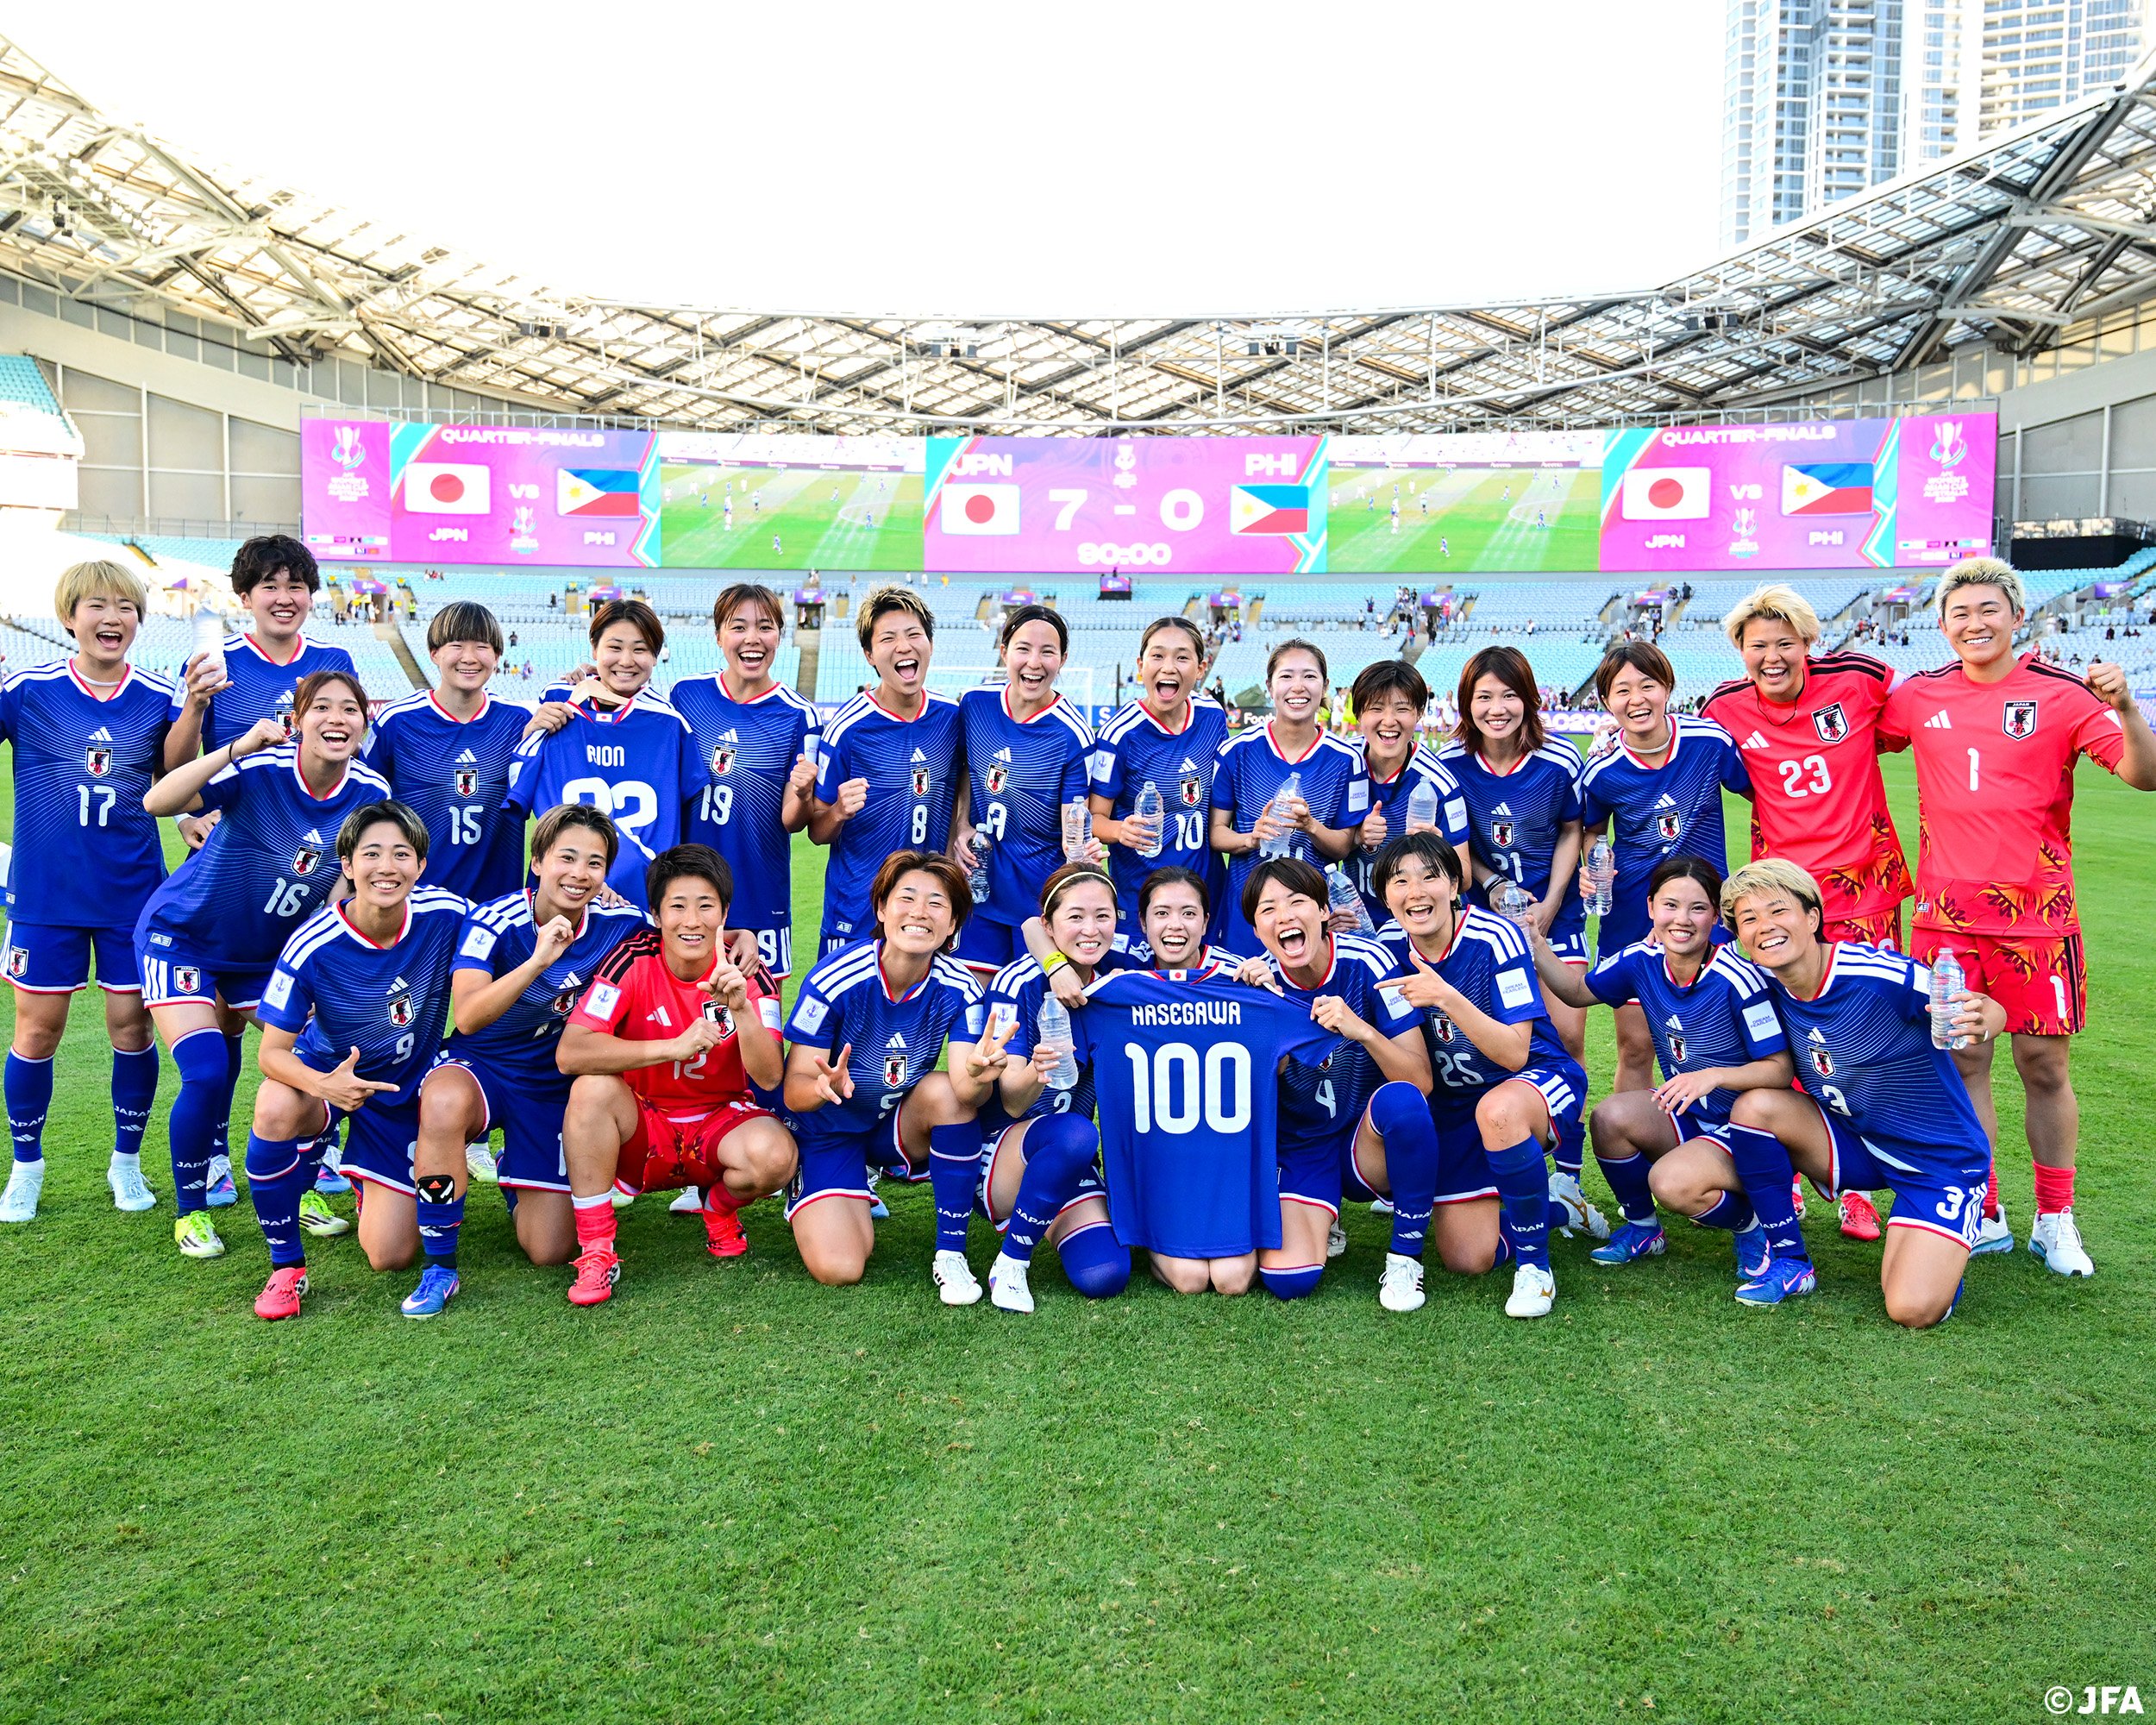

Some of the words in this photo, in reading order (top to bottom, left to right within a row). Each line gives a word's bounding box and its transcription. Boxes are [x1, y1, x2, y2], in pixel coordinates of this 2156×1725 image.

[441, 429, 605, 448] QUARTER-FINALS
[1662, 425, 1836, 447] QUARTER-FINALS
[950, 454, 1012, 477] JPN
[1245, 454, 1297, 477] PHI
[509, 484, 540, 500] VS
[1730, 485, 1763, 500] VS
[1049, 489, 1087, 530] 7
[1159, 488, 1204, 531] 0
[429, 528, 468, 543] JPN
[584, 531, 615, 545] PHI
[1645, 533, 1685, 549] JPN
[1808, 530, 1843, 545] PHI
[1077, 543, 1172, 565] 90:00
[1778, 755, 1832, 798] 23
[1967, 747, 1979, 792] 1
[77, 784, 116, 826] 17
[699, 783, 734, 825] 19
[448, 805, 484, 844] 15
[912, 805, 927, 844] 8
[1175, 811, 1203, 851] 10
[263, 876, 310, 917] 16
[1502, 985, 1527, 994] FEARLESS
[1504, 982, 1523, 991] DREAM
[2049, 975, 2068, 1019] 1
[1388, 996, 1406, 1007] FEARLE
[1389, 994, 1403, 1003] DREA
[1750, 1017, 1775, 1028] FEARLESS
[1752, 1015, 1771, 1025] DREAM
[392, 1032, 414, 1064] 9
[1434, 1051, 1484, 1087] 25
[1125, 1042, 1251, 1133] 100
[1315, 1078, 1336, 1119] 4
[114, 1106, 152, 1117] JAPAN
[1822, 1085, 1852, 1116] 3
[1936, 1186, 1965, 1220] 3
[257, 1214, 291, 1226] APAN
[1016, 1208, 1054, 1225] JAPAN
